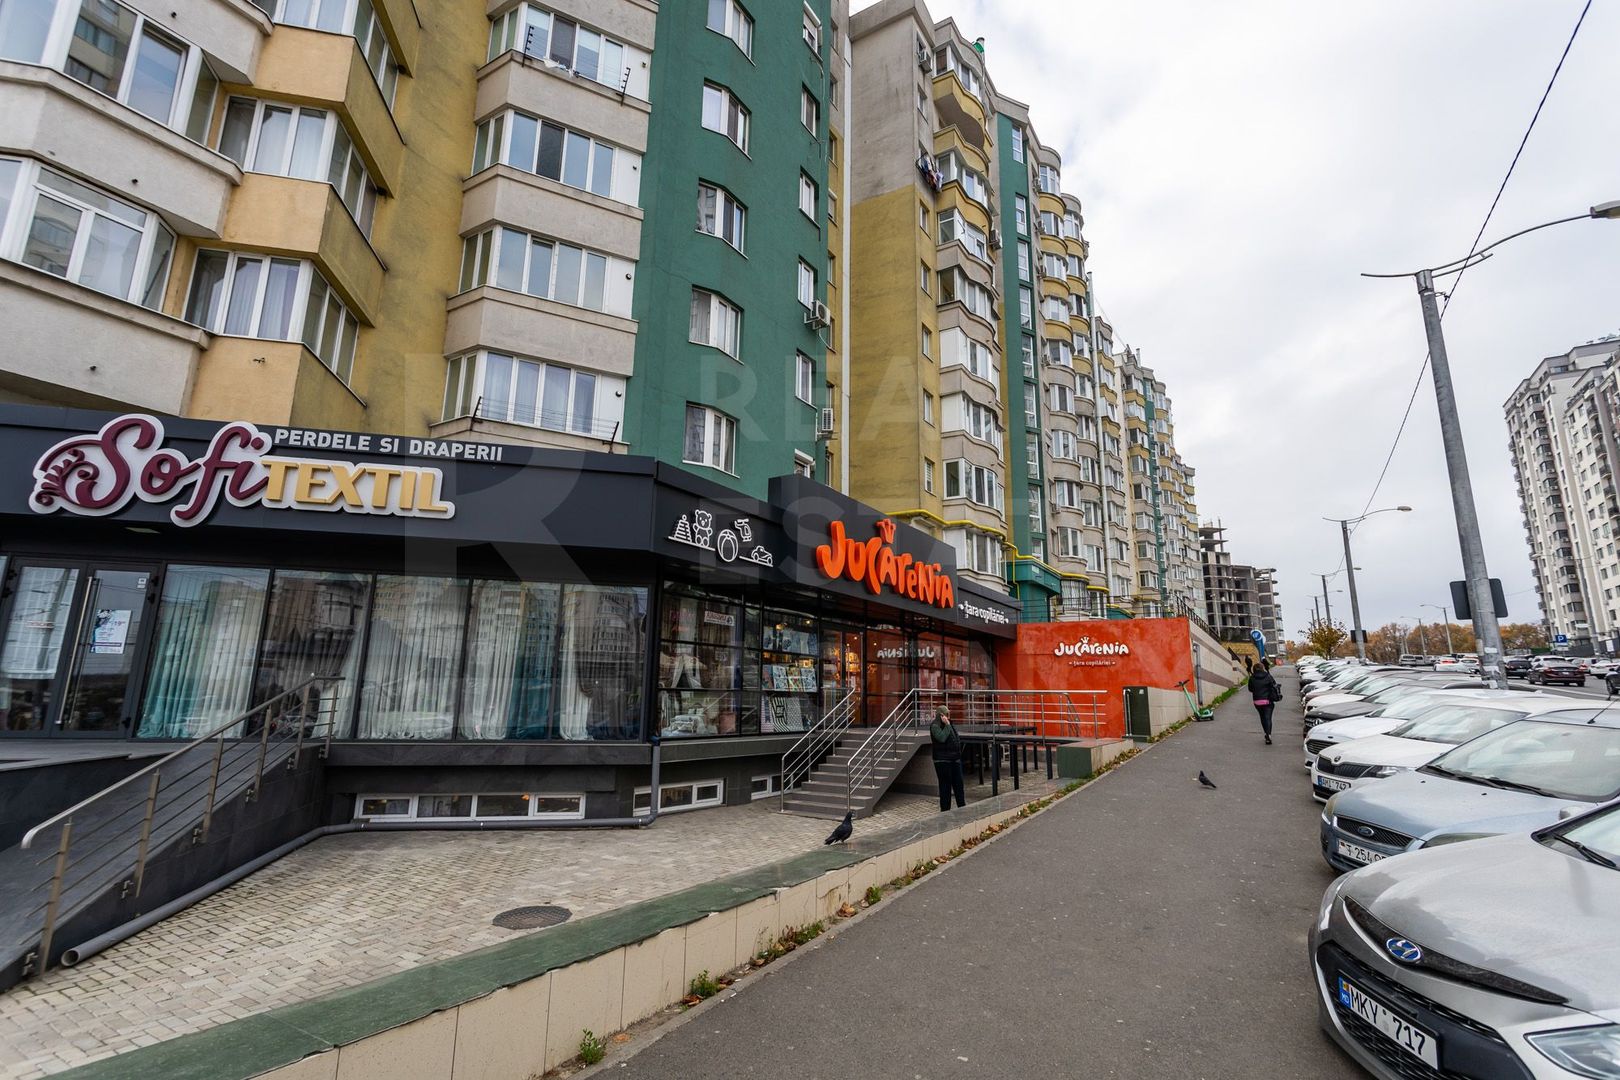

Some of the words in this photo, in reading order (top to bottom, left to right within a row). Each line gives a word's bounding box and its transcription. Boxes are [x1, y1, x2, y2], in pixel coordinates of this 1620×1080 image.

[35, 418, 269, 520] Sofi
[274, 428, 372, 451] PERDELE
[379, 437, 399, 453] SI
[409, 439, 503, 462] DRAPERII
[261, 460, 449, 513] TEXTIL
[1350, 987, 1379, 1025] MKY
[1393, 1017, 1426, 1056] 717
